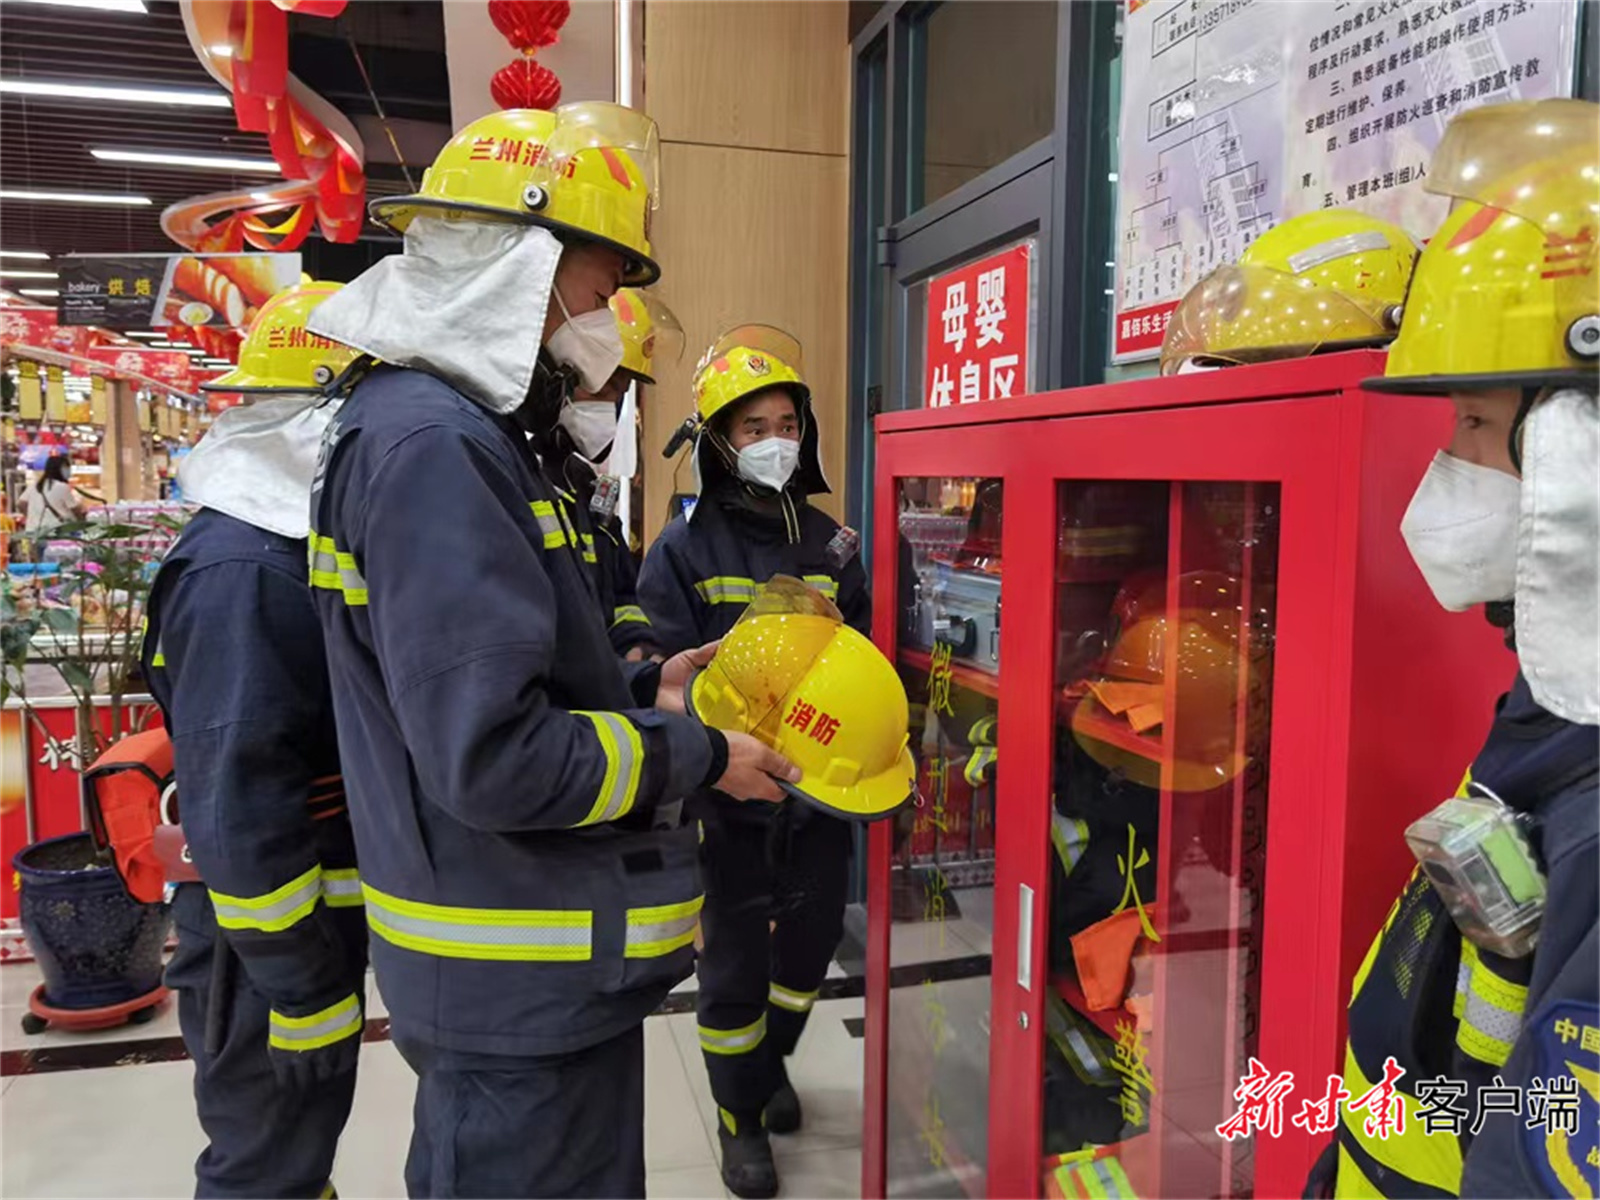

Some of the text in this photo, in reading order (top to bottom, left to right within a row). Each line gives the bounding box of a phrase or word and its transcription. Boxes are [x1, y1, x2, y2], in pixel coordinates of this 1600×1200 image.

[469, 137, 578, 179] 兰州消防
[67, 281, 100, 293] bakery
[942, 266, 1007, 354] 母婴
[268, 325, 350, 350] 兰州消
[784, 697, 842, 747] 消防
